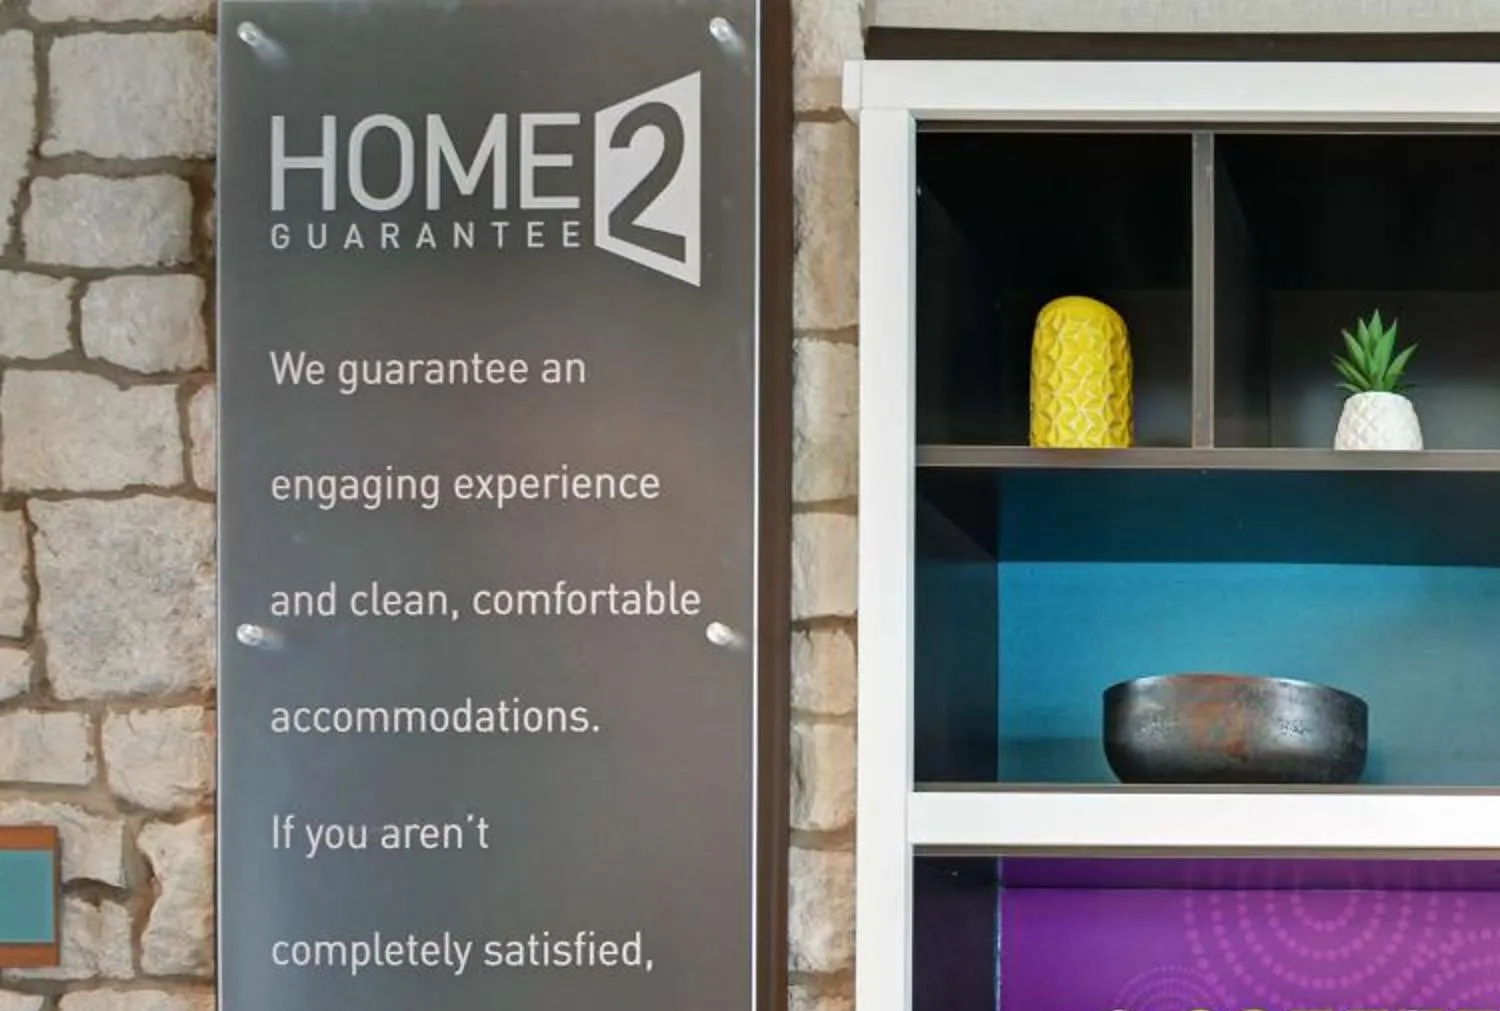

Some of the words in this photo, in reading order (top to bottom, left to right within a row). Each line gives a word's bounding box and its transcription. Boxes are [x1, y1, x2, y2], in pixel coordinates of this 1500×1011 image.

[271, 112, 581, 212] HOME
[605, 100, 688, 266] 2
[271, 221, 581, 250] GUARANTEE
[270, 351, 325, 385] We
[339, 352, 529, 396] guarantee
[542, 359, 586, 384] an
[271, 465, 440, 511] engaging
[453, 464, 661, 510] experience
[270, 580, 337, 617] and
[350, 580, 459, 621] clean,
[472, 579, 701, 617] comfortable
[271, 697, 600, 734] accommodations.
[273, 815, 295, 849] If
[306, 823, 367, 859] you
[380, 813, 489, 850] aren't
[272, 931, 473, 977] completely
[483, 931, 653, 972] satisfied,
